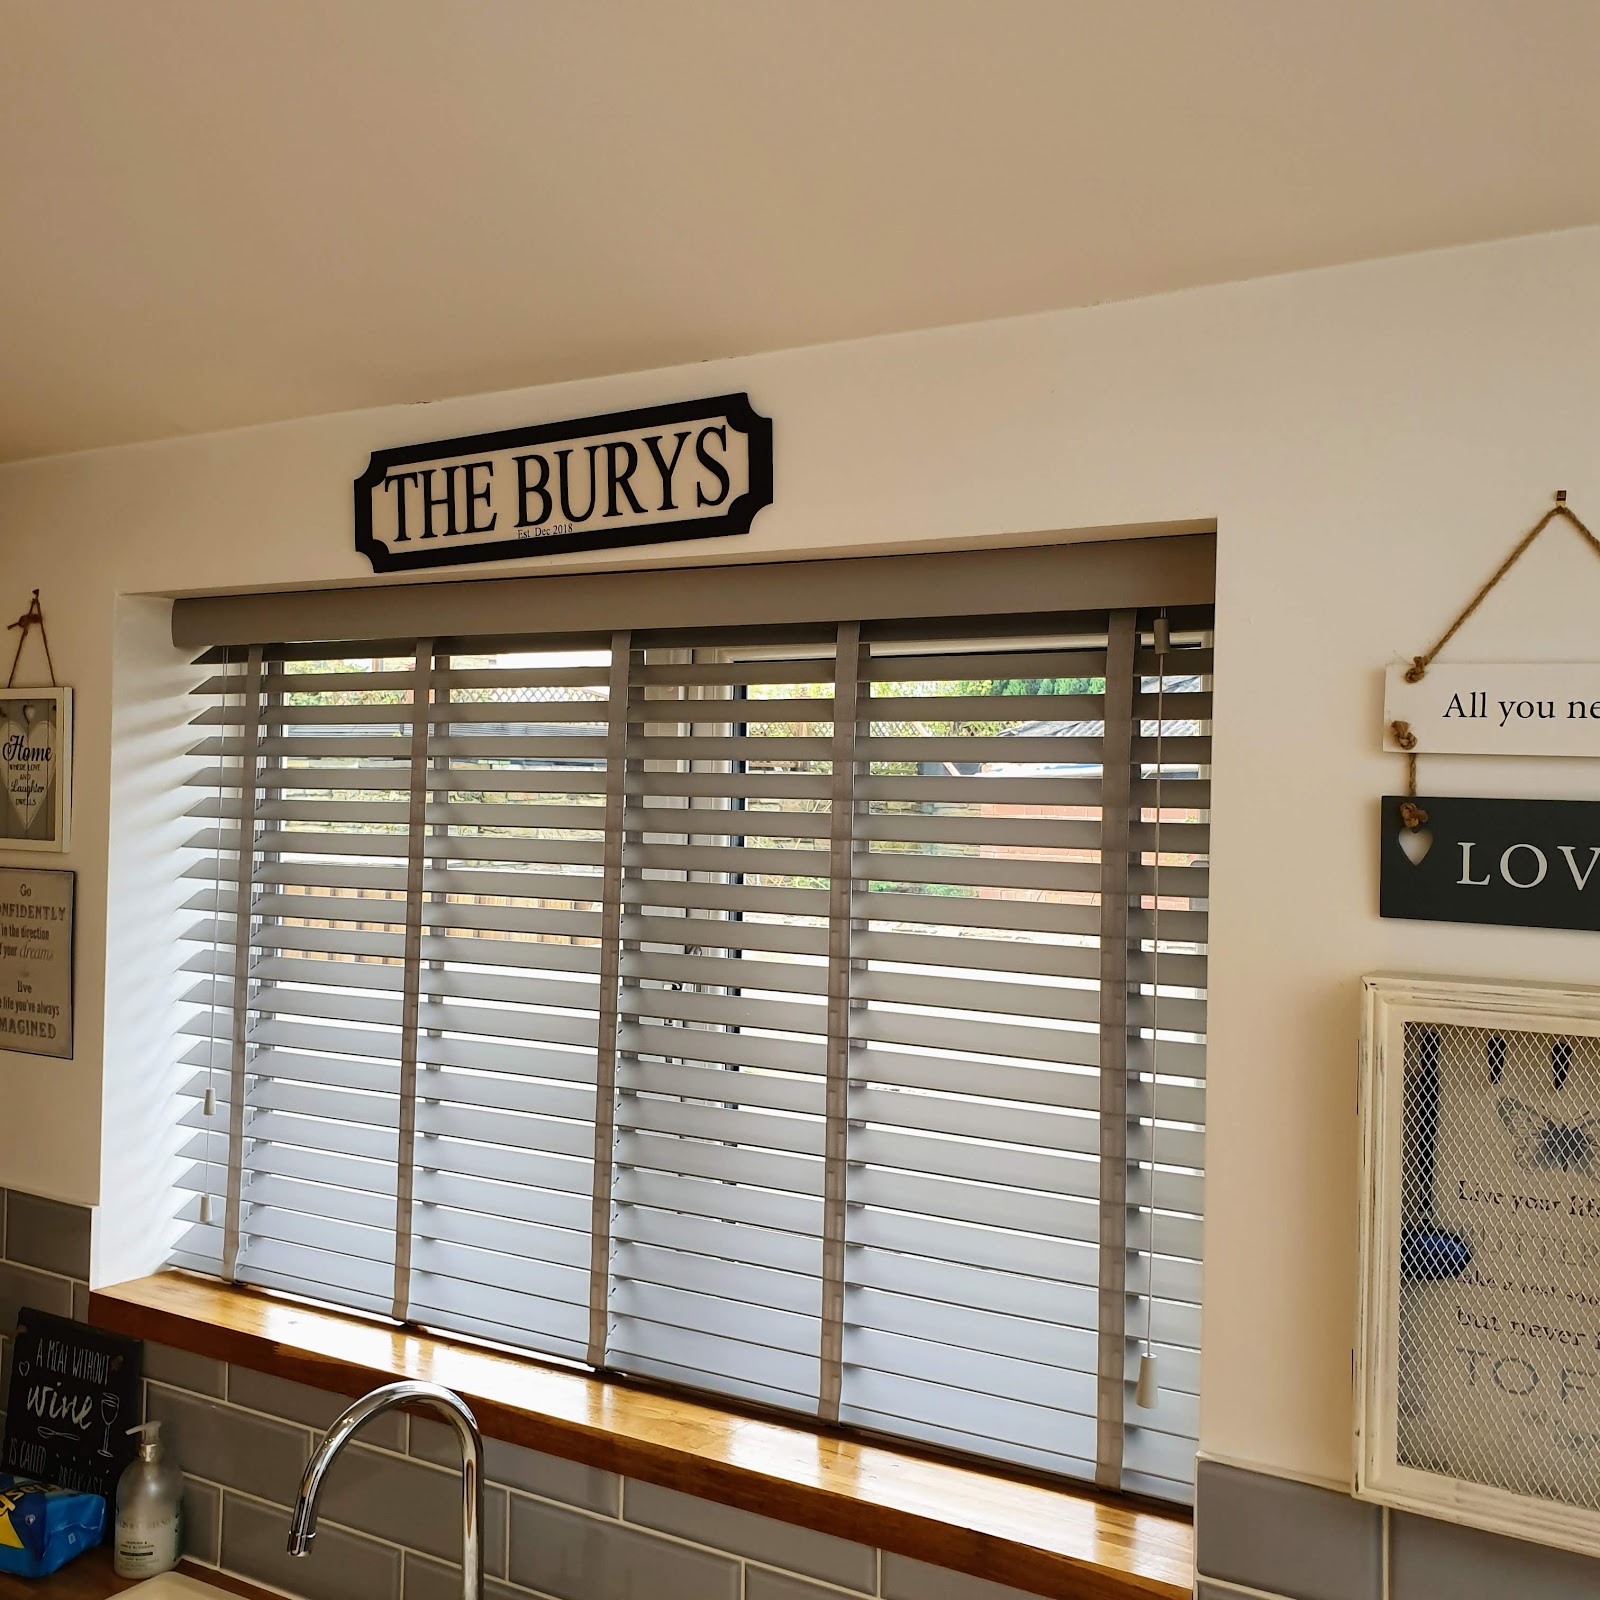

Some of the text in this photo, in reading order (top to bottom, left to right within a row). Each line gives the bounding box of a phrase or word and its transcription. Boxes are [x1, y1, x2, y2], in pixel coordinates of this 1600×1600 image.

[384, 424, 730, 543] THE BURYS
[534, 527, 550, 537] Dec
[553, 523, 573, 535] 2018
[1442, 691, 1600, 727] All you ne
[2, 734, 53, 762] Home
[1456, 842, 1600, 891] LOV
[20, 883, 32, 897] Go
[0, 902, 66, 921] NFIDENTLY
[1, 923, 49, 941] in the direction
[3, 945, 18, 960] your
[3, 996, 60, 1019] life you've always
[1457, 1179, 1504, 1206] Live
[1510, 1193, 1561, 1215] your
[1455, 1305, 1501, 1333] but
[1510, 1319, 1588, 1347] never
[36, 1338, 111, 1387] A MEAL WITHOUT
[1456, 1347, 1540, 1397] TO
[26, 1381, 94, 1430] wine
[8, 1437, 47, 1474] IS CALLED
